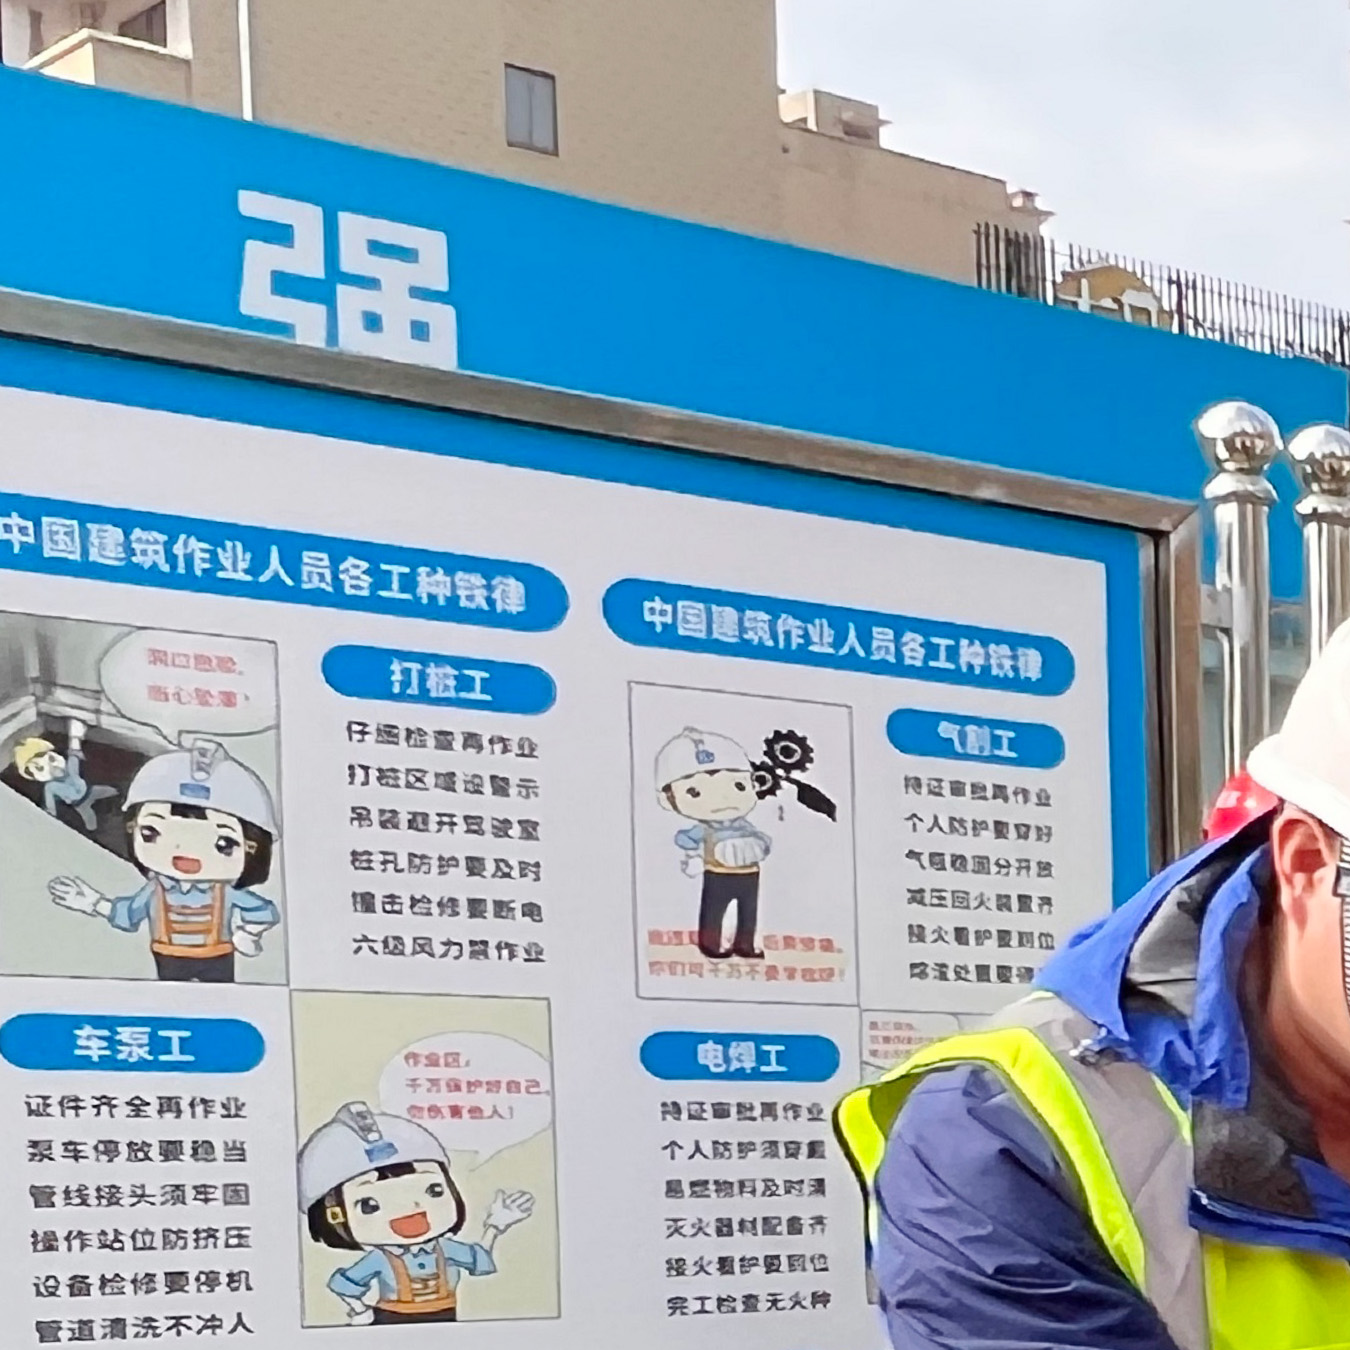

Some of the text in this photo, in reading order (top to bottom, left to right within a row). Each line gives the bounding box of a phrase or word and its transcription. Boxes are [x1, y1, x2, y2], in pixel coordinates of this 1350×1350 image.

[237, 189, 457, 369] 强
[1, 511, 527, 616] 中国建筑作业人员各工种铁律
[642, 595, 1043, 683] 中国建筑作业人员各工种铁律
[390, 657, 493, 701] 打桩工
[74, 1025, 195, 1063] 车泵工
[697, 1040, 788, 1073] 电焊工
[24, 1094, 247, 1120] 证件齐全再作业
[27, 1139, 248, 1164] 泵车停放要稳当
[29, 1182, 251, 1209] 管线接头须牢固
[31, 1226, 252, 1254] 操作站位防挤压
[33, 1269, 254, 1299] 设备检修要停机
[35, 1312, 255, 1344] 管道清洗不冲人
